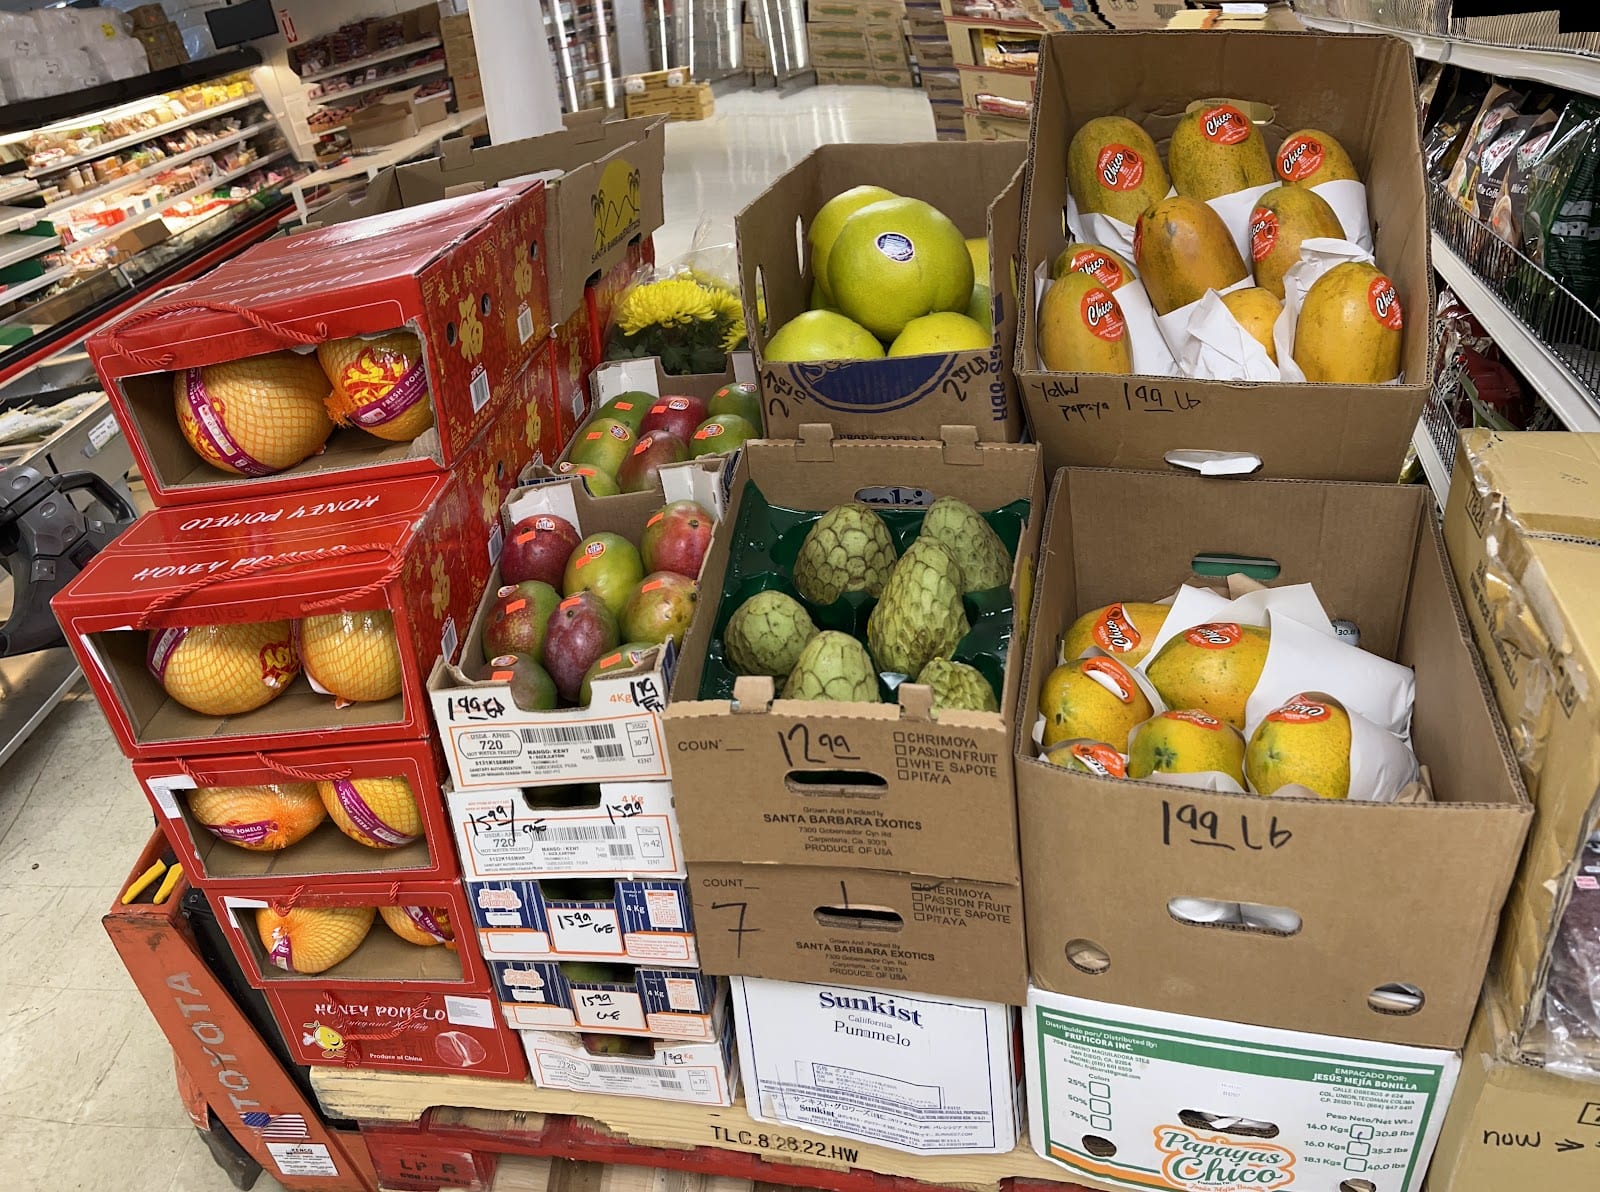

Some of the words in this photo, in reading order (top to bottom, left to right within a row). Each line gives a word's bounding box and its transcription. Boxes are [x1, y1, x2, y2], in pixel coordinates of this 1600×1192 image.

[1206, 112, 1232, 136] Chico
[1283, 143, 1308, 175] Chico
[1103, 152, 1125, 186] Chico
[1087, 300, 1113, 327] Chico
[286, 494, 381, 520] HONEY
[179, 508, 284, 531] POMELO
[479, 739, 503, 751] 720
[763, 812, 804, 826] SANTA
[808, 814, 874, 829] BARBARA
[875, 818, 923, 831] EXOTICS
[493, 838, 515, 848] 720
[804, 843, 857, 855] PRODUCE
[857, 845, 873, 855] OF
[702, 878, 744, 888] COUNT
[924, 893, 976, 908] PASSION
[978, 900, 1012, 914] FRUIT
[924, 903, 962, 917] WHITE
[964, 908, 1012, 925] SAPOTE
[925, 914, 968, 928] PITAYA
[711, 901, 762, 959] 7
[795, 941, 832, 953] SANTA
[890, 949, 936, 962] EXOTICS
[829, 967, 875, 979] PRODUCE
[875, 971, 887, 980] OF
[889, 972, 908, 981] USA
[818, 990, 923, 1029] Sunkist
[167, 971, 260, 1111] TOYOTA
[1065, 1031, 1114, 1048] FRUTICORA
[1115, 1042, 1134, 1051] INC.
[1067, 1077, 1087, 1089] 25%
[1312, 1073, 1343, 1083] JESÚS
[1344, 1076, 1374, 1088] MEJÍA
[1374, 1080, 1418, 1091] BONILLA
[1334, 1068, 1385, 1080] EMPACADO
[1067, 1094, 1088, 1106] 50%
[799, 1104, 835, 1118] Sunkist
[1069, 1110, 1089, 1122] 75%
[1326, 1112, 1348, 1120] Peso
[1306, 1123, 1328, 1131] 14.0
[1330, 1124, 1350, 1134] Kgs
[1375, 1130, 1399, 1138] 30.8
[1163, 1131, 1284, 1164] Papayas
[1303, 1140, 1326, 1148] 16.0
[1327, 1142, 1346, 1152] Kgs
[1483, 1130, 1541, 1148] now
[1172, 1156, 1284, 1184] Chico
[1303, 1156, 1322, 1164] 18.1
[1322, 1158, 1342, 1168] Kgs
[1367, 1163, 1391, 1171] 40.0
